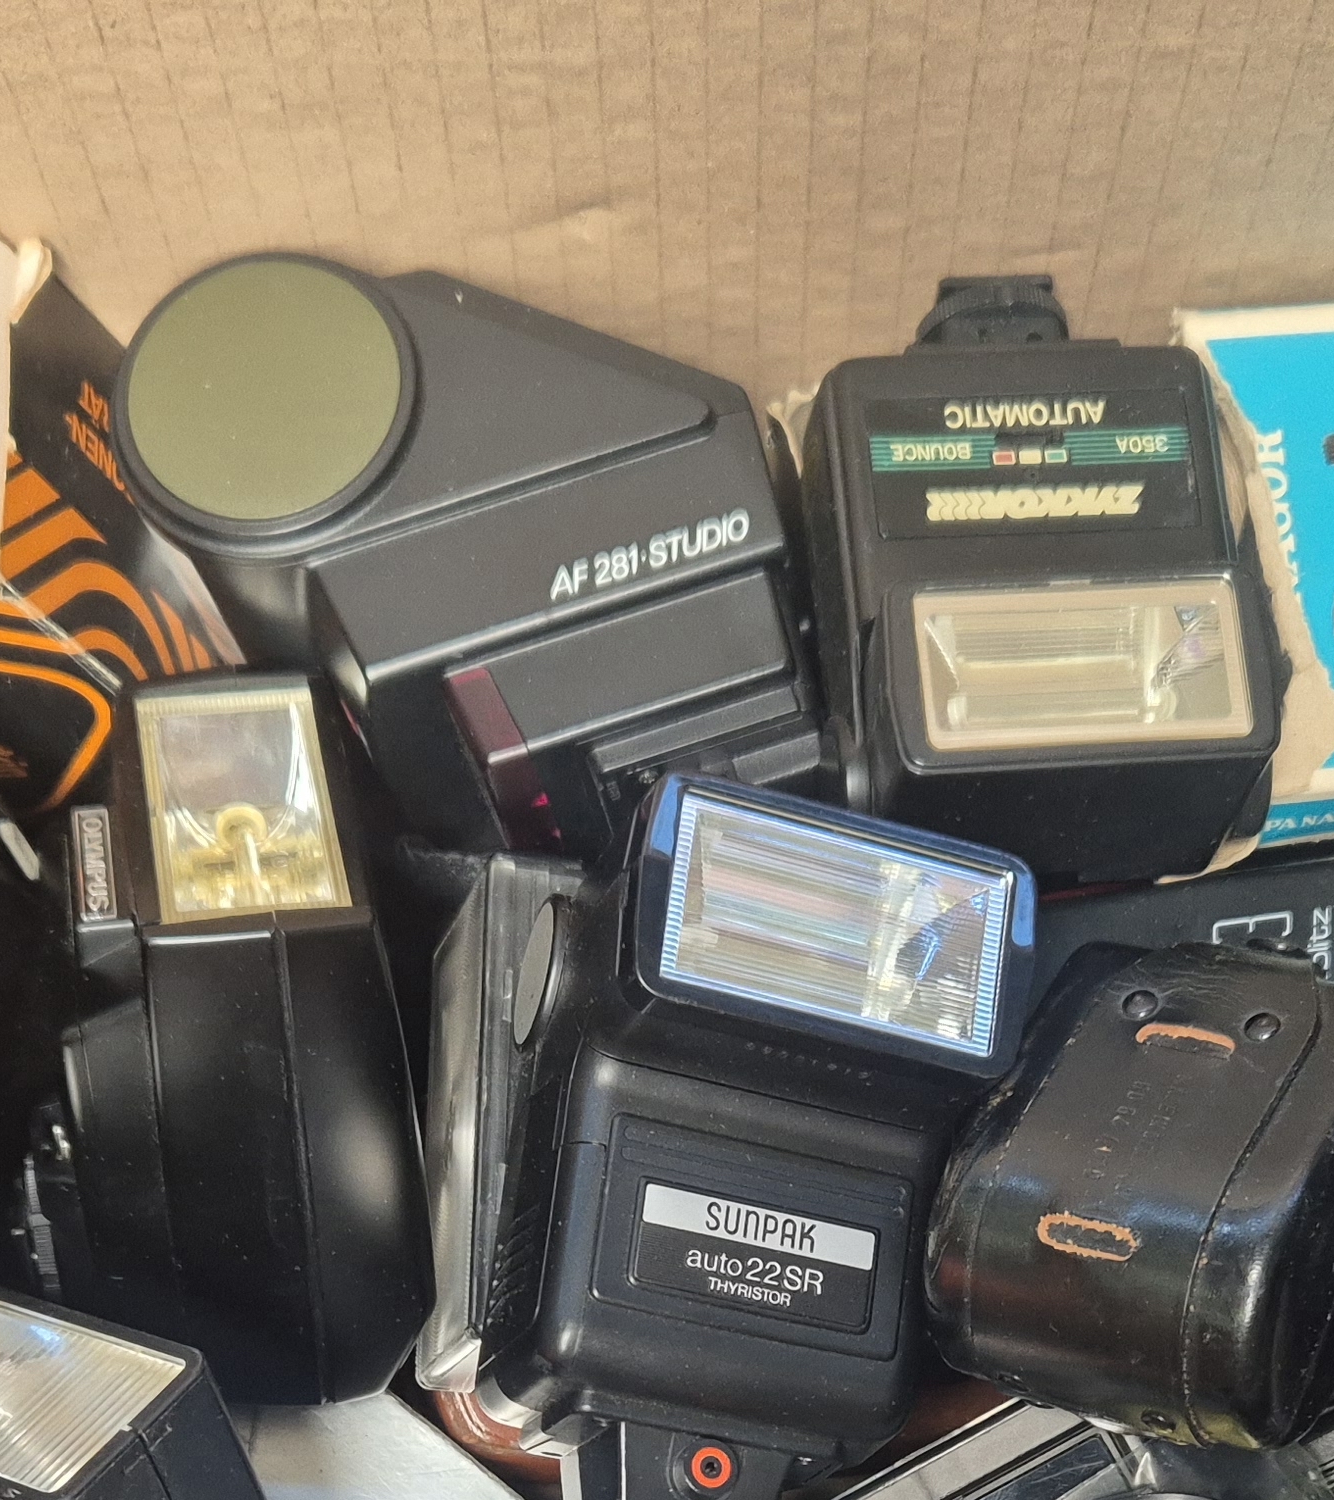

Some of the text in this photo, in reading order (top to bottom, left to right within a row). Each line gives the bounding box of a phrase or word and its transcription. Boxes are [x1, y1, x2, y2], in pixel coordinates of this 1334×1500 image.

[944, 399, 1107, 430] AUTOMATIC
[890, 433, 1169, 462] 350A BOUNCE
[550, 558, 589, 601] AF
[82, 817, 109, 912] OLYMPUS
[705, 1201, 817, 1253] SUNPAK
[708, 1276, 792, 1307] THYRISTOR
